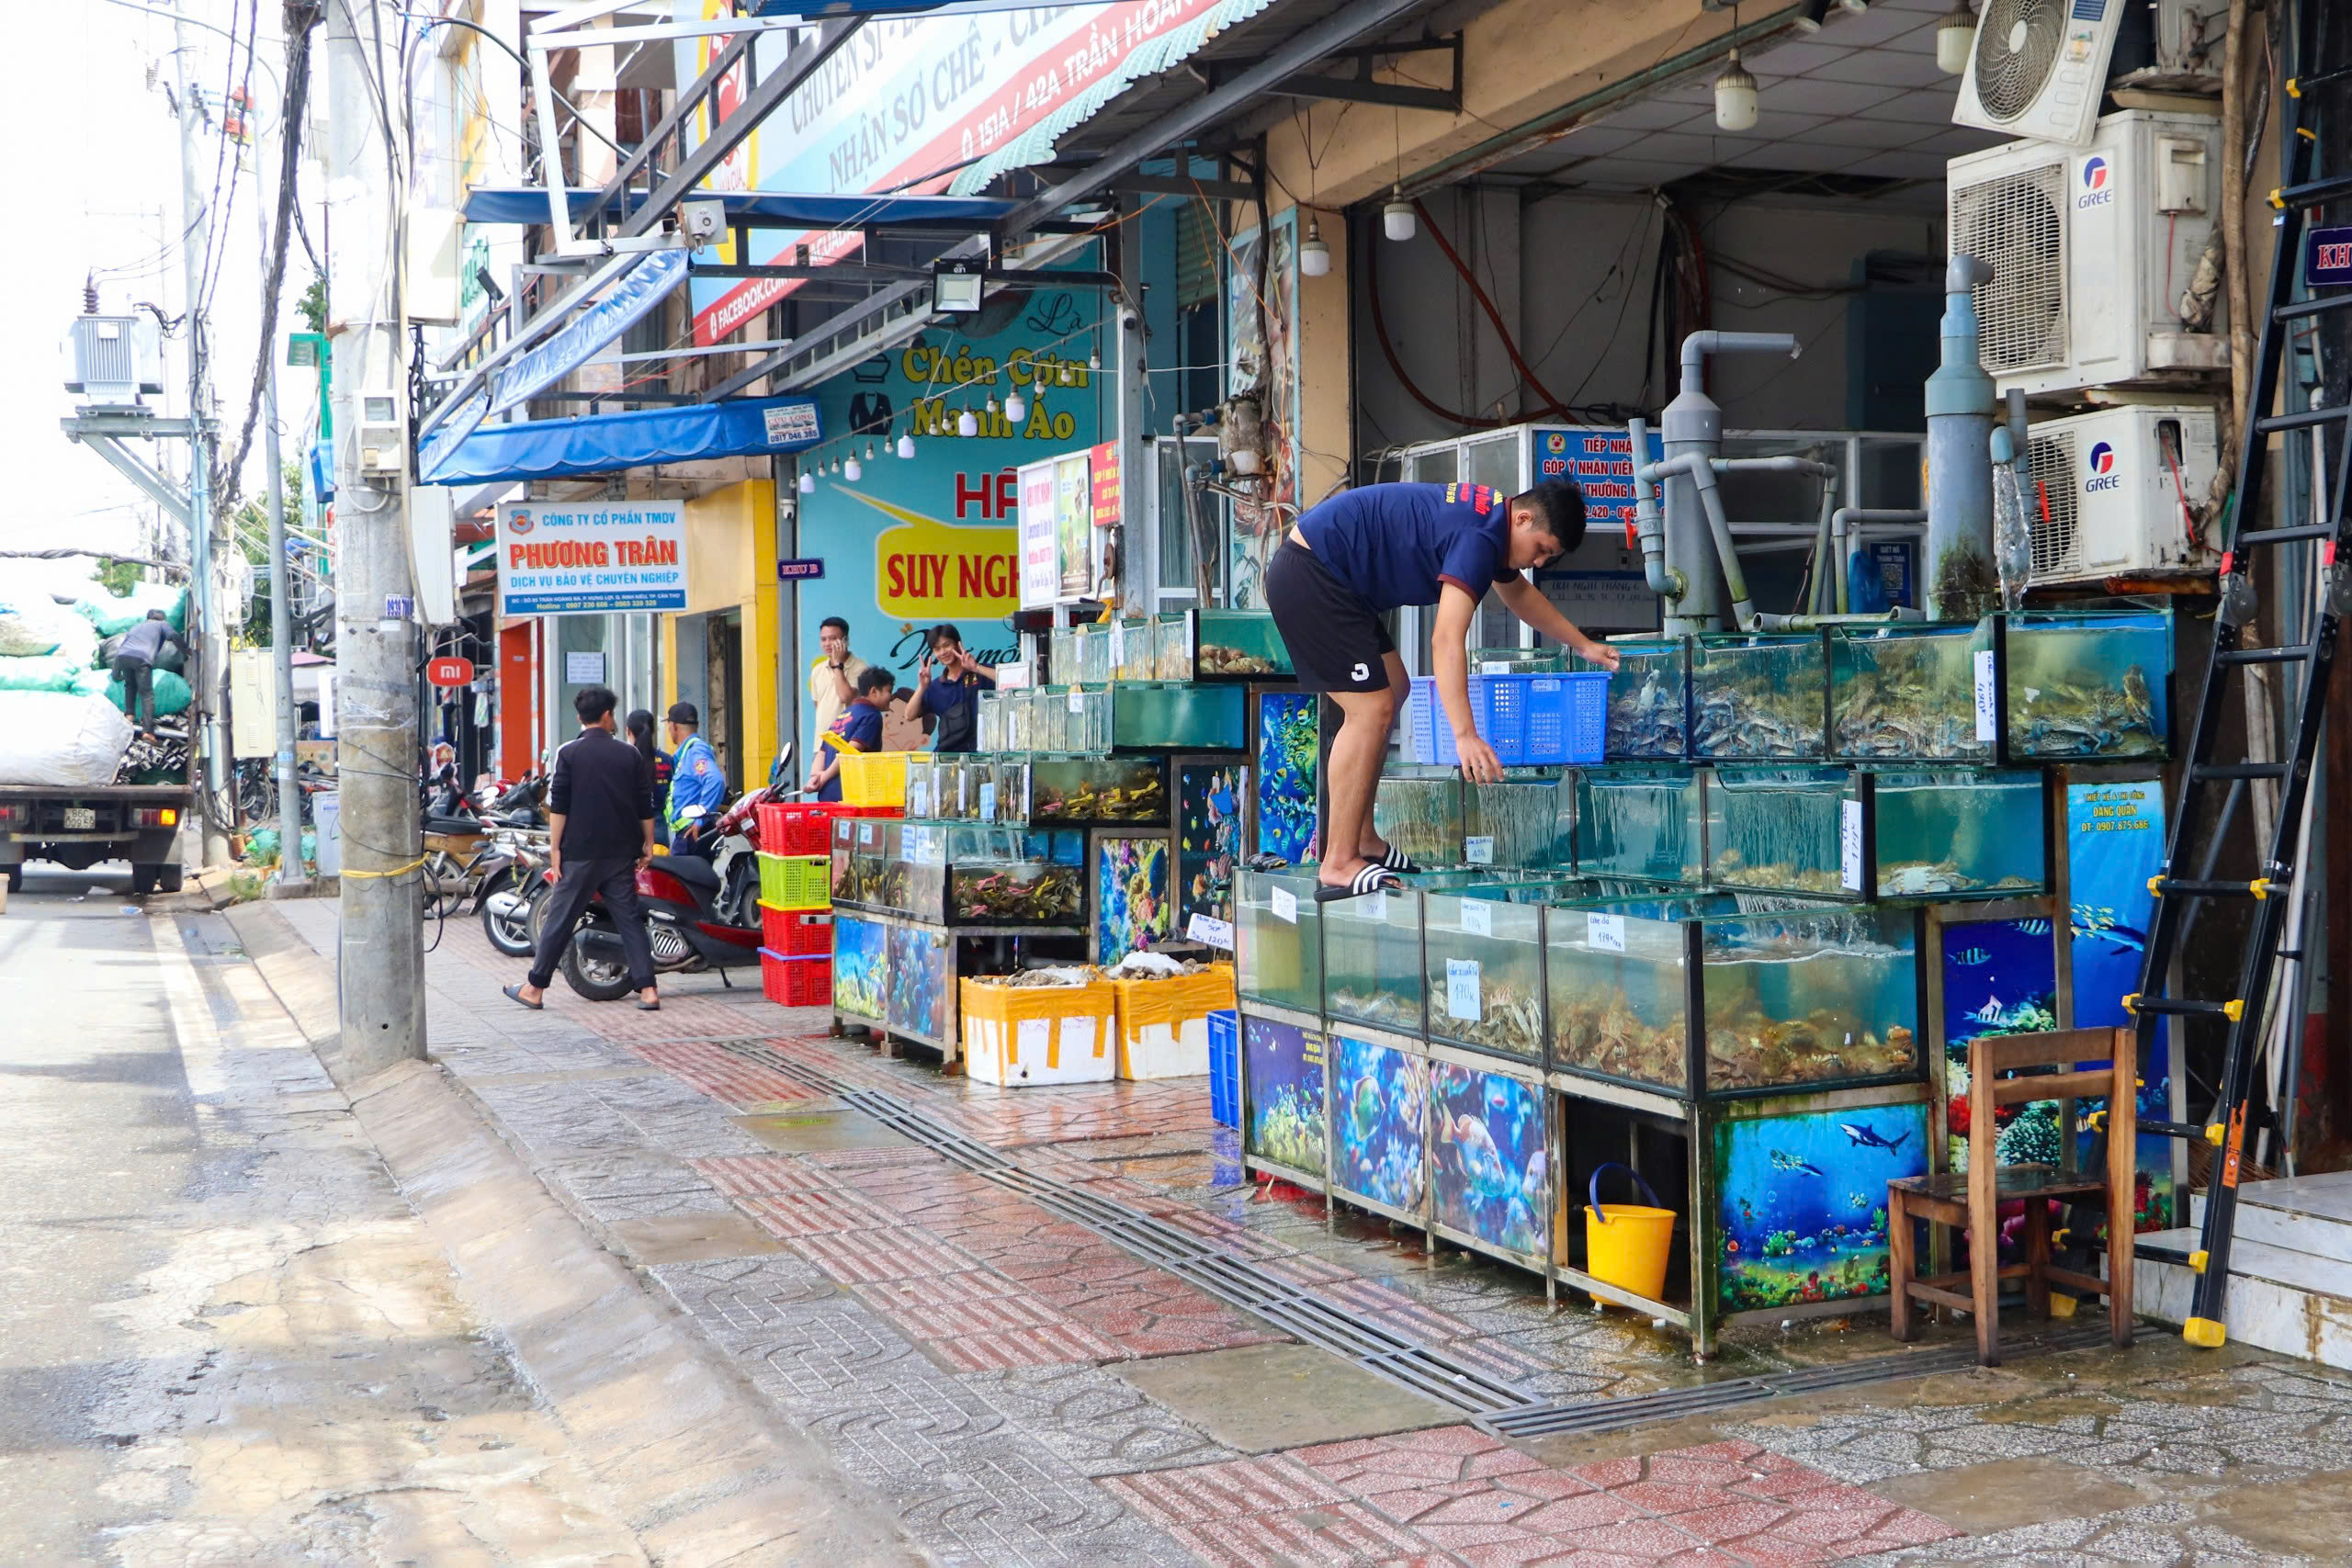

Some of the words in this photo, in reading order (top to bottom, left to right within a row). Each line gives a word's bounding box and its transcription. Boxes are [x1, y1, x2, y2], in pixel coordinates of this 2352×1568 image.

[1063, 22, 1118, 87] TRẦN
[2078, 188, 2113, 209] GREE
[2316, 243, 2352, 269] KH
[901, 344, 997, 386] Chén
[1007, 347, 1089, 389] Cơm
[911, 397, 1013, 439] Manh
[1023, 392, 1076, 440] Áo
[1583, 434, 1608, 454] TIẾP
[1610, 436, 1633, 457] NHẬ
[1543, 457, 1566, 475] GÓP
[1567, 457, 1577, 474] Ý
[1577, 457, 1610, 476] NHÂN
[1584, 479, 1629, 498] THƯỞNG
[2086, 474, 2121, 493] GREE
[542, 511, 573, 526] CÔNG
[577, 513, 589, 525] TY
[611, 508, 642, 525] PHẦN
[645, 512, 676, 525] TMDV
[509, 539, 610, 570] PHƯƠNG
[614, 535, 679, 566] TRÂN
[511, 574, 536, 591] DỊCH
[539, 575, 552, 589] VỤ
[556, 571, 577, 587] BẢO
[581, 571, 594, 588] VỆ
[596, 570, 638, 585] CHUYÊN
[640, 570, 680, 587] NGHIỆP
[887, 553, 949, 598] SUY
